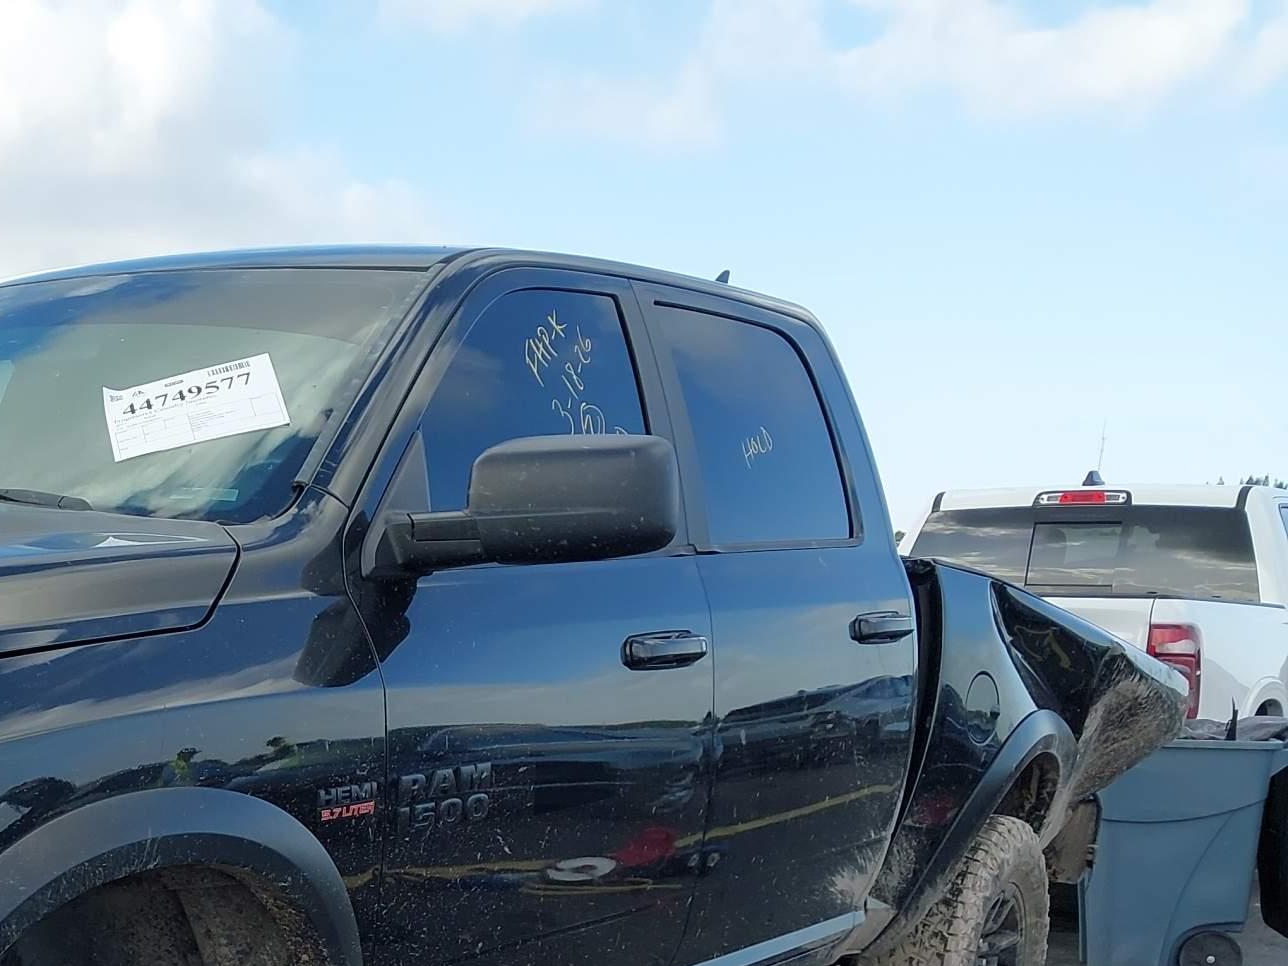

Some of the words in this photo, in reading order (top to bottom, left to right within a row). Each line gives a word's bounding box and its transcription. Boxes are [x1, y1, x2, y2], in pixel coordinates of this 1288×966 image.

[122, 371, 251, 415] 44749577
[741, 426, 773, 470] HOLD
[318, 781, 377, 804] HEMI
[398, 762, 492, 800] RAM
[320, 807, 341, 822] 5.7
[398, 793, 489, 833] 1500
